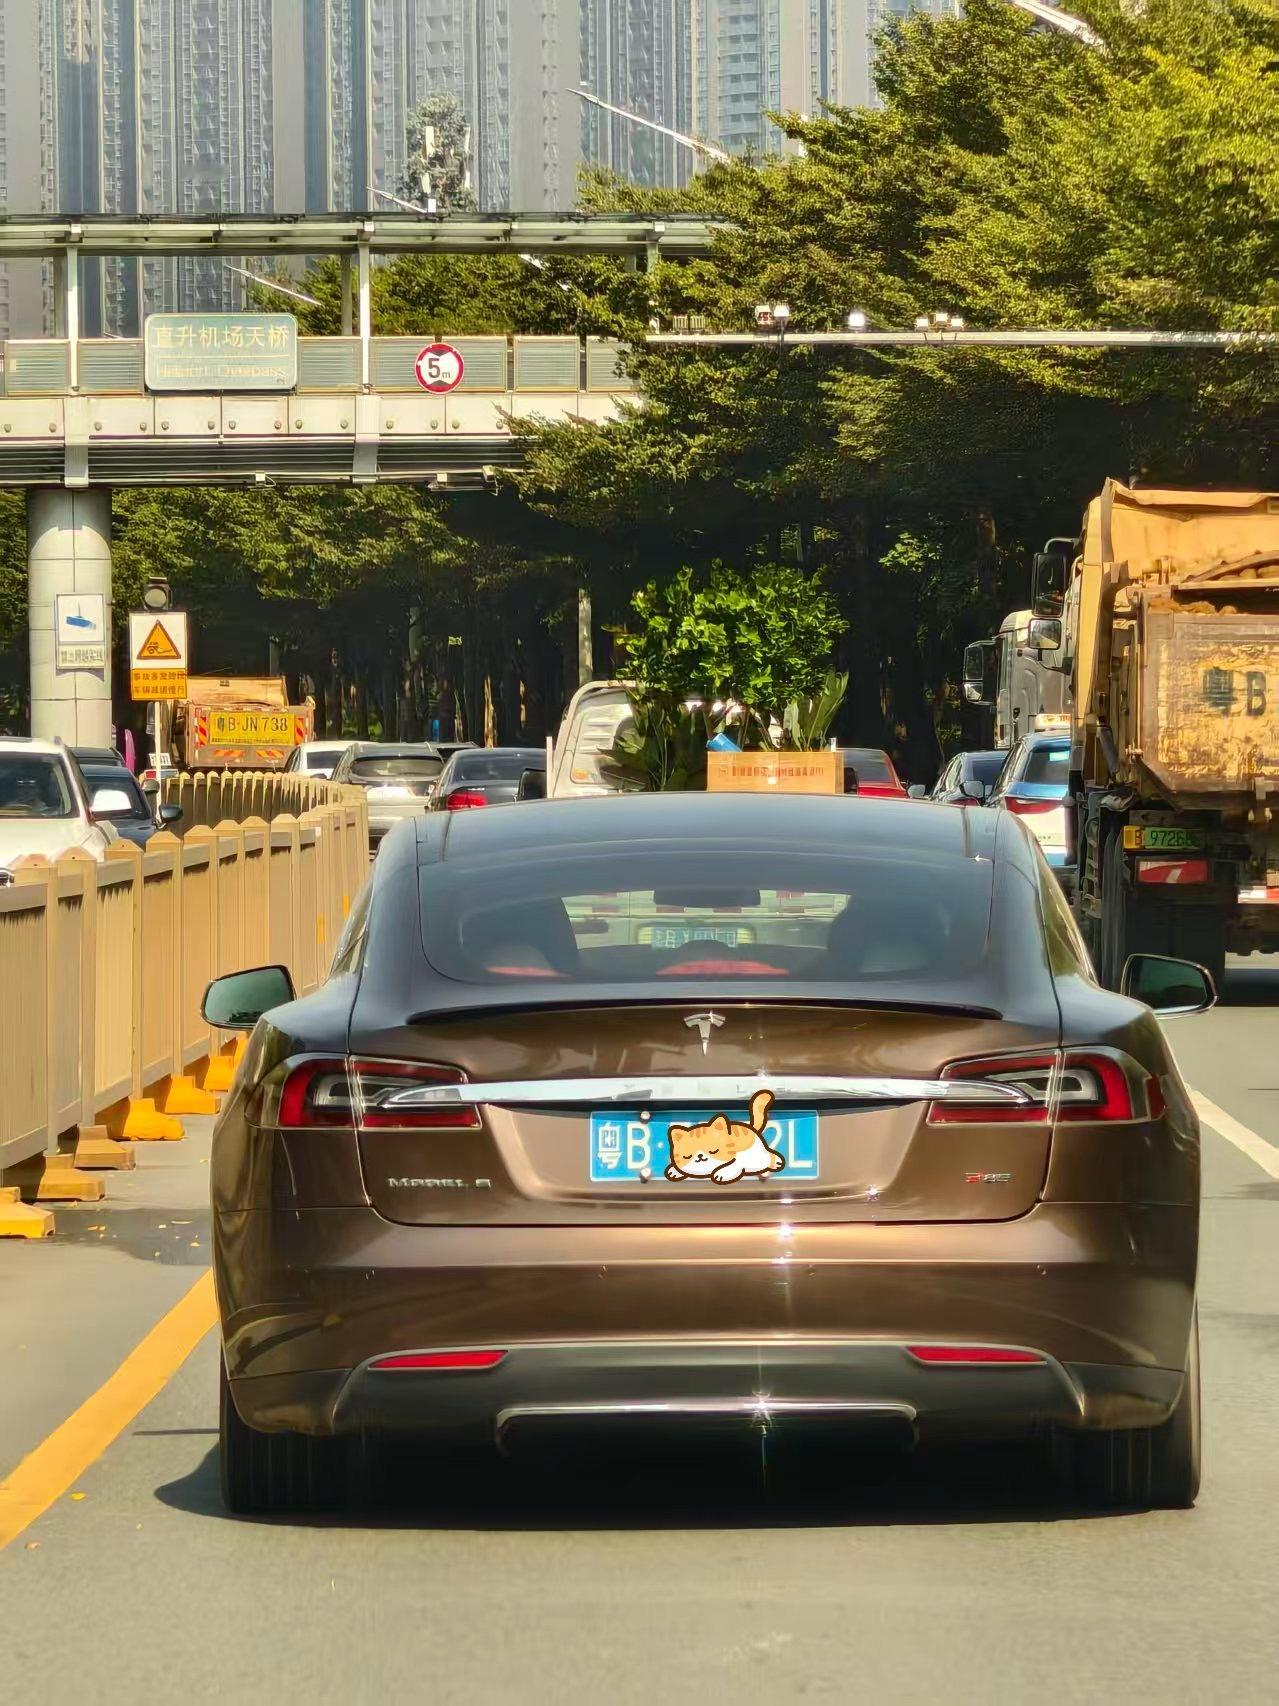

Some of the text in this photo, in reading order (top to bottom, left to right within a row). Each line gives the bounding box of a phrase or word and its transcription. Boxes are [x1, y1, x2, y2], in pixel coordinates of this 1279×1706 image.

[151, 323, 289, 348] 直升机场天桥
